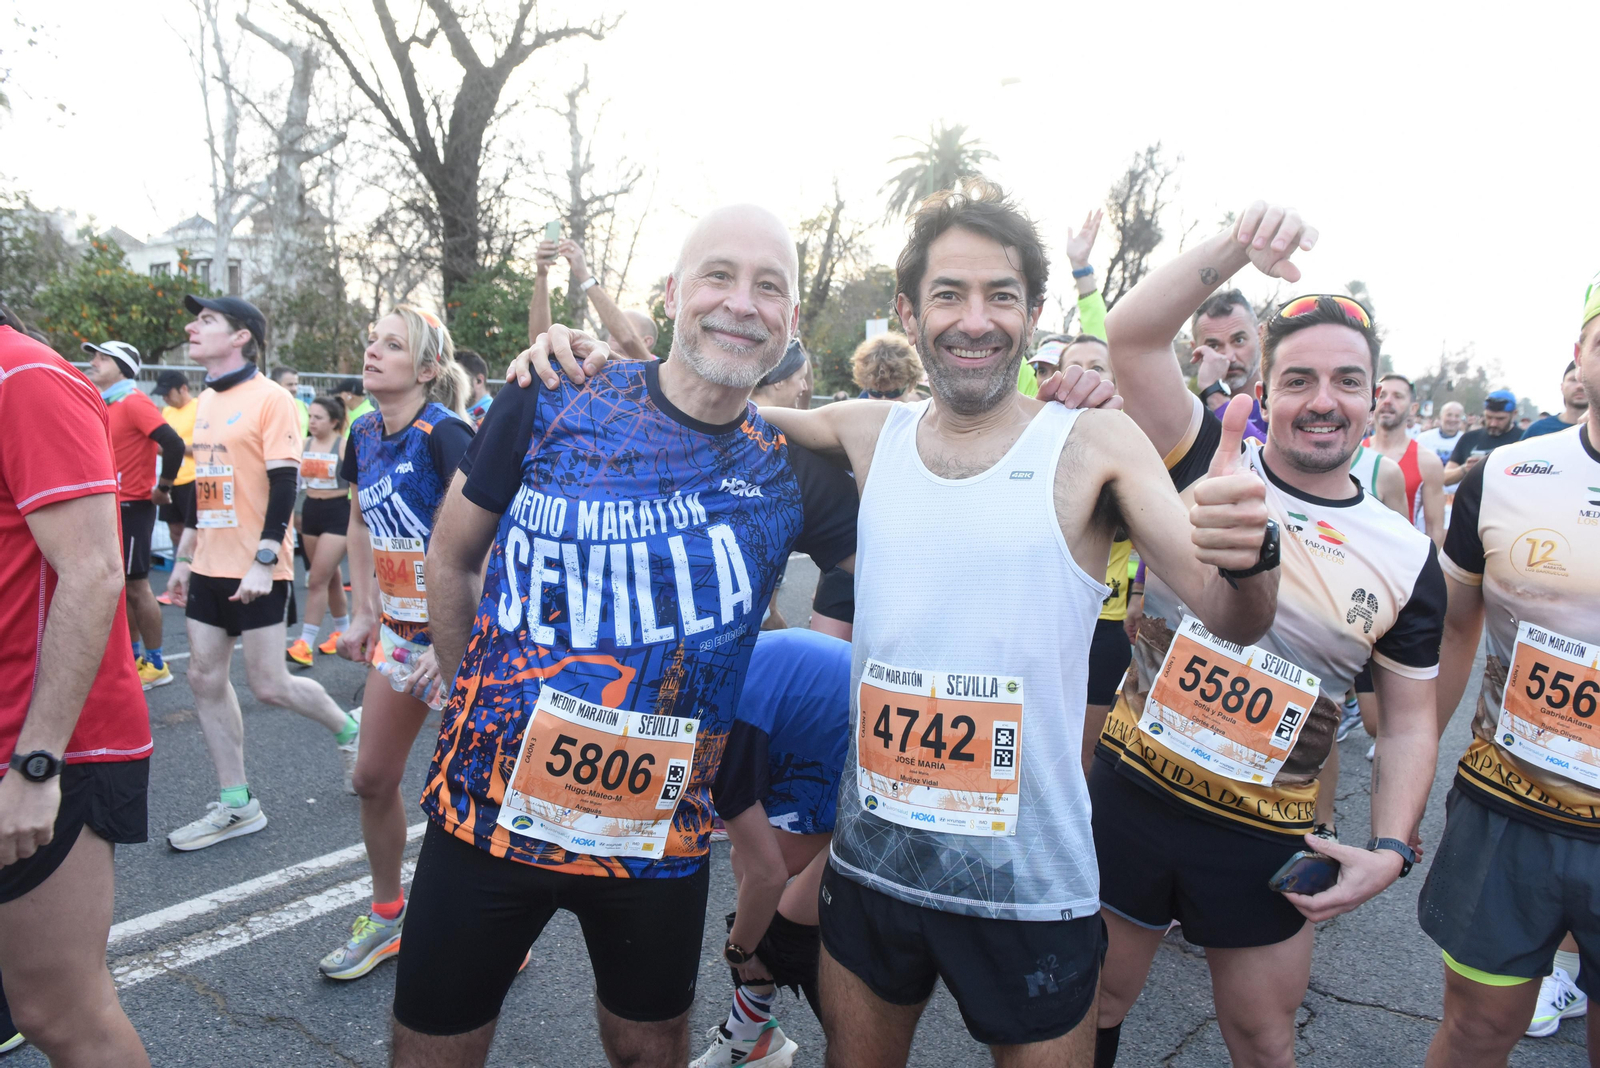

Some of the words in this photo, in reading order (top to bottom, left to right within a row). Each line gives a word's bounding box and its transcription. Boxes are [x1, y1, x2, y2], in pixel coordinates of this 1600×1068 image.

[1512, 463, 1553, 475] global
[718, 478, 764, 498] HOKA
[510, 483, 568, 538] MEDIO
[577, 490, 708, 541] MARATÓN
[1578, 516, 1598, 526] LOS
[390, 538, 412, 550] SEVILLA
[1526, 538, 1558, 568] 12
[498, 522, 752, 648] SEVILLA
[700, 639, 713, 652] 29
[714, 622, 747, 647] EDICIÓN
[1527, 627, 1547, 645] MEDIO
[1549, 635, 1587, 658] MARATÓN
[1261, 653, 1303, 685] SEVILLA
[868, 663, 885, 681] MEDIO
[886, 670, 923, 688] MARATÓN
[946, 674, 998, 698] SEVILLA
[1179, 655, 1273, 724] 5580
[1526, 662, 1600, 718] 556
[550, 692, 576, 714] MEDIO
[576, 703, 619, 727] MARATÓN
[638, 714, 680, 737] SEVILLA
[1192, 715, 1209, 727] Cortés
[1194, 700, 1210, 712] Sofía
[1217, 712, 1236, 725] Paula
[1540, 707, 1593, 730] GabrielAitana
[874, 704, 976, 762] 4742
[1541, 723, 1559, 733] Rubio
[1560, 729, 1582, 741] Olivera
[525, 743, 535, 764] CAJÓN
[546, 734, 656, 794] 5806
[895, 755, 915, 766] JOSÉ
[918, 760, 946, 770] MARÍA
[1190, 746, 1211, 762] HOKA
[1545, 755, 1570, 769] HOKA
[900, 774, 920, 784] Muñoz
[564, 783, 623, 802] Hugo-Mateo-M
[1217, 789, 1250, 810] DE
[575, 803, 602, 815] Araguás
[911, 812, 935, 823] HOKA
[571, 836, 596, 848] HOKA
